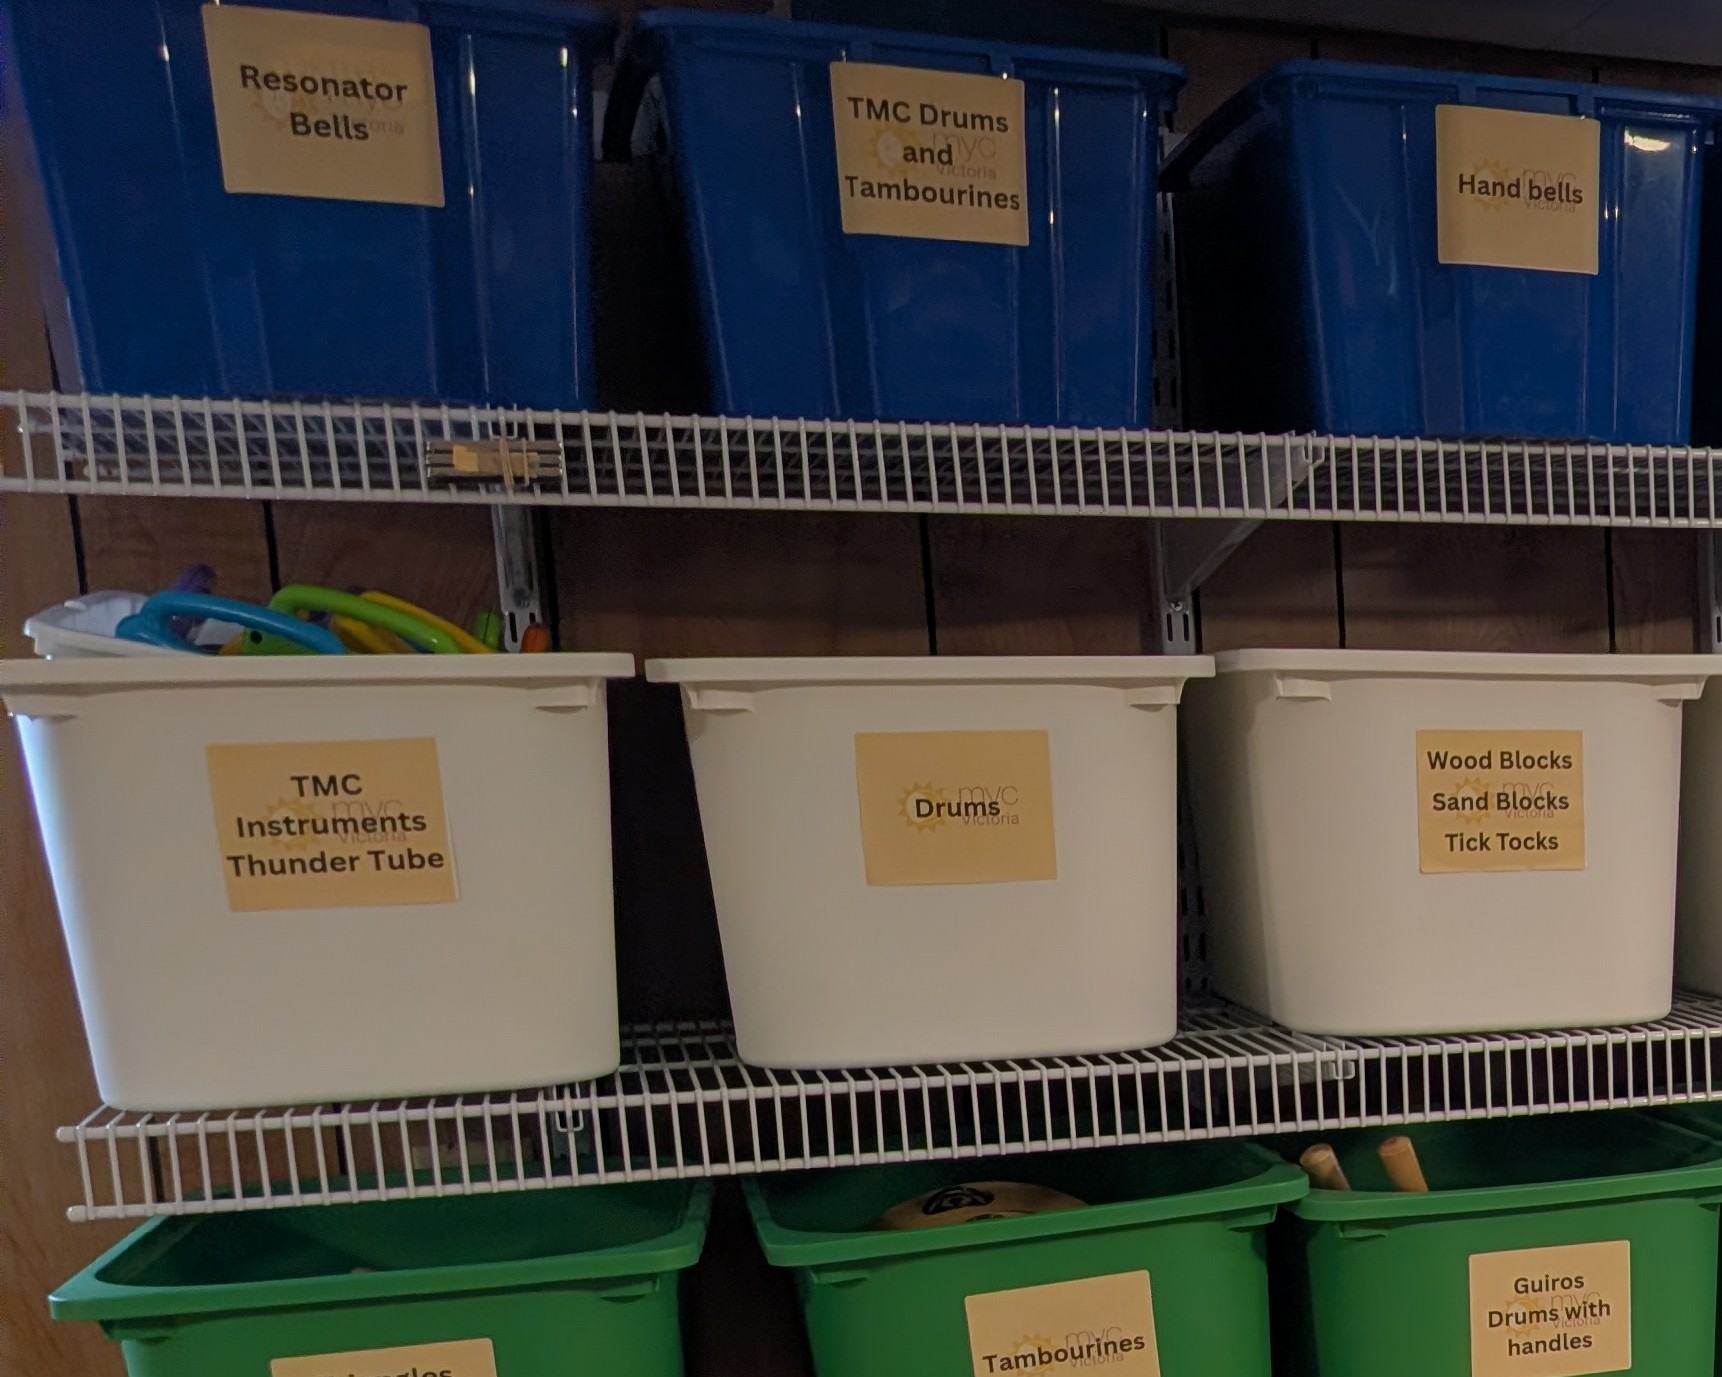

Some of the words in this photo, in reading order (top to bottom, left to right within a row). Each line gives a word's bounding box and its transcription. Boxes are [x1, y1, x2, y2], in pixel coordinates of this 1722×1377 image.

[240, 64, 408, 102] Resonator
[290, 111, 369, 141] Bells
[848, 96, 911, 123] TMC
[919, 103, 1009, 133] Drums
[903, 144, 953, 166] and
[845, 176, 1020, 211] Tambourines
[1458, 173, 1521, 199] Hand
[1528, 179, 1583, 204] bells
[1427, 750, 1492, 770] Wood
[1500, 750, 1573, 770] Blocks
[290, 774, 363, 798] TMC
[915, 798, 1000, 818] Drums
[1432, 791, 1488, 811] Sand
[1496, 791, 1570, 811] Blocks
[236, 812, 427, 838] Instruments
[1445, 832, 1491, 852] Tick
[1496, 831, 1559, 851] Tocks
[226, 851, 359, 877] Thunder
[367, 848, 444, 871] Tube
[1514, 1274, 1585, 1294] Guiros
[1488, 1307, 1558, 1328] Drums
[1565, 1299, 1611, 1320] with
[982, 1335, 1146, 1374] Tambourines
[1508, 1332, 1593, 1356] handles
